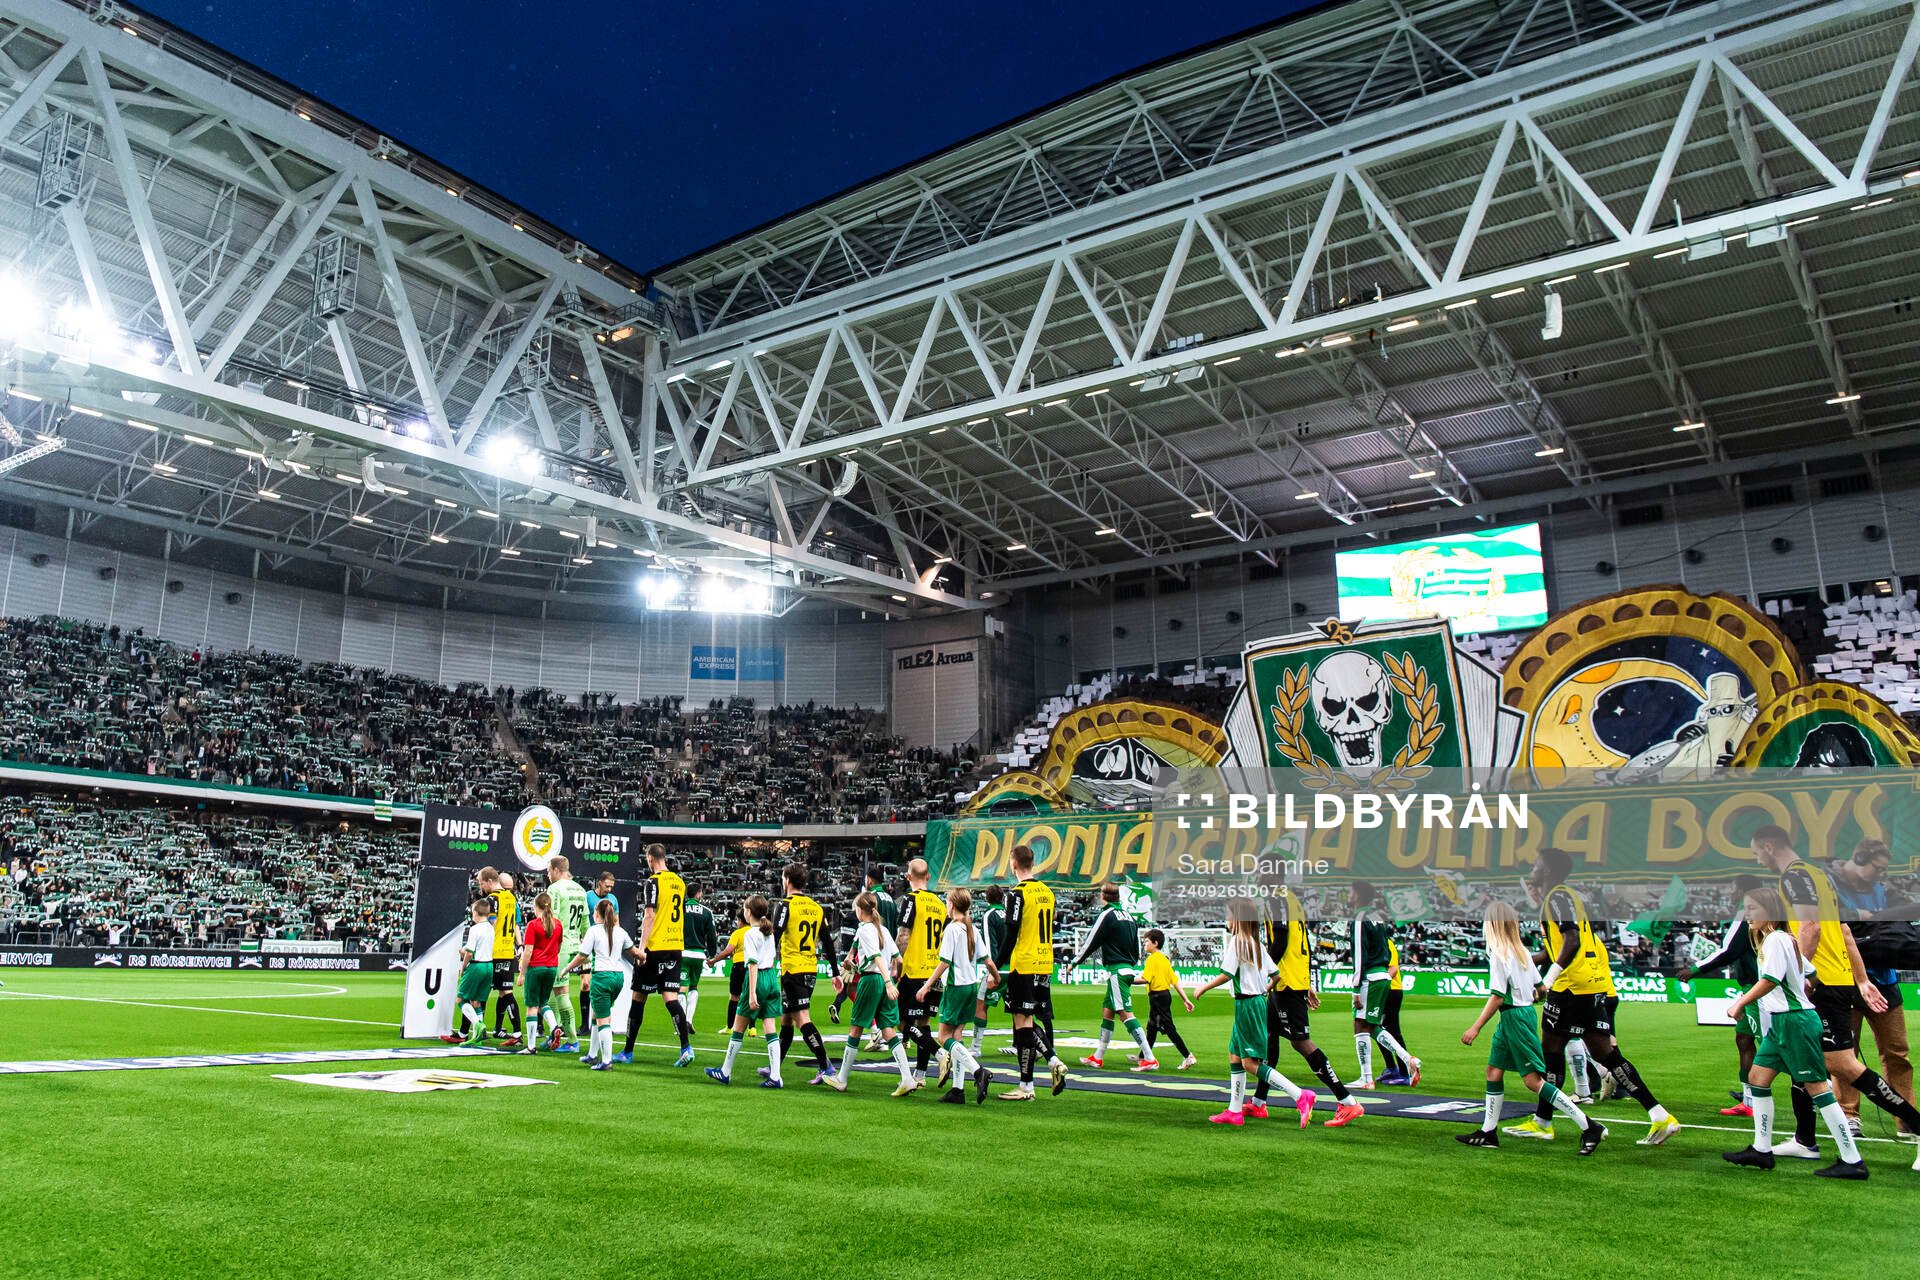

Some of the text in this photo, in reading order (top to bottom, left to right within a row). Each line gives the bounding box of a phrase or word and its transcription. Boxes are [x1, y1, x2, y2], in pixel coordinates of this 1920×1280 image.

[1327, 619, 1354, 645] 25
[693, 656, 735, 664] AMERICAN
[897, 650, 974, 671] TELE2 Arena
[436, 818, 502, 842] UNIBET
[1645, 783, 1892, 864] BOYS
[573, 831, 630, 853] UNIBET
[569, 904, 584, 930] 26
[671, 894, 681, 923] 3
[502, 913, 515, 938] 14
[798, 920, 818, 951] 21
[925, 917, 943, 950] 19
[1038, 908, 1051, 944] 11
[0, 953, 52, 966] ERVICE
[129, 953, 232, 968] RS RÖRSERVICE
[269, 956, 360, 969] RS RÖRSERVICE
[424, 968, 442, 996] U
[1613, 977, 1667, 992] SCHAS
[1761, 1113, 1769, 1133] CRAFT
[1838, 1123, 1850, 1143] CRAFT
